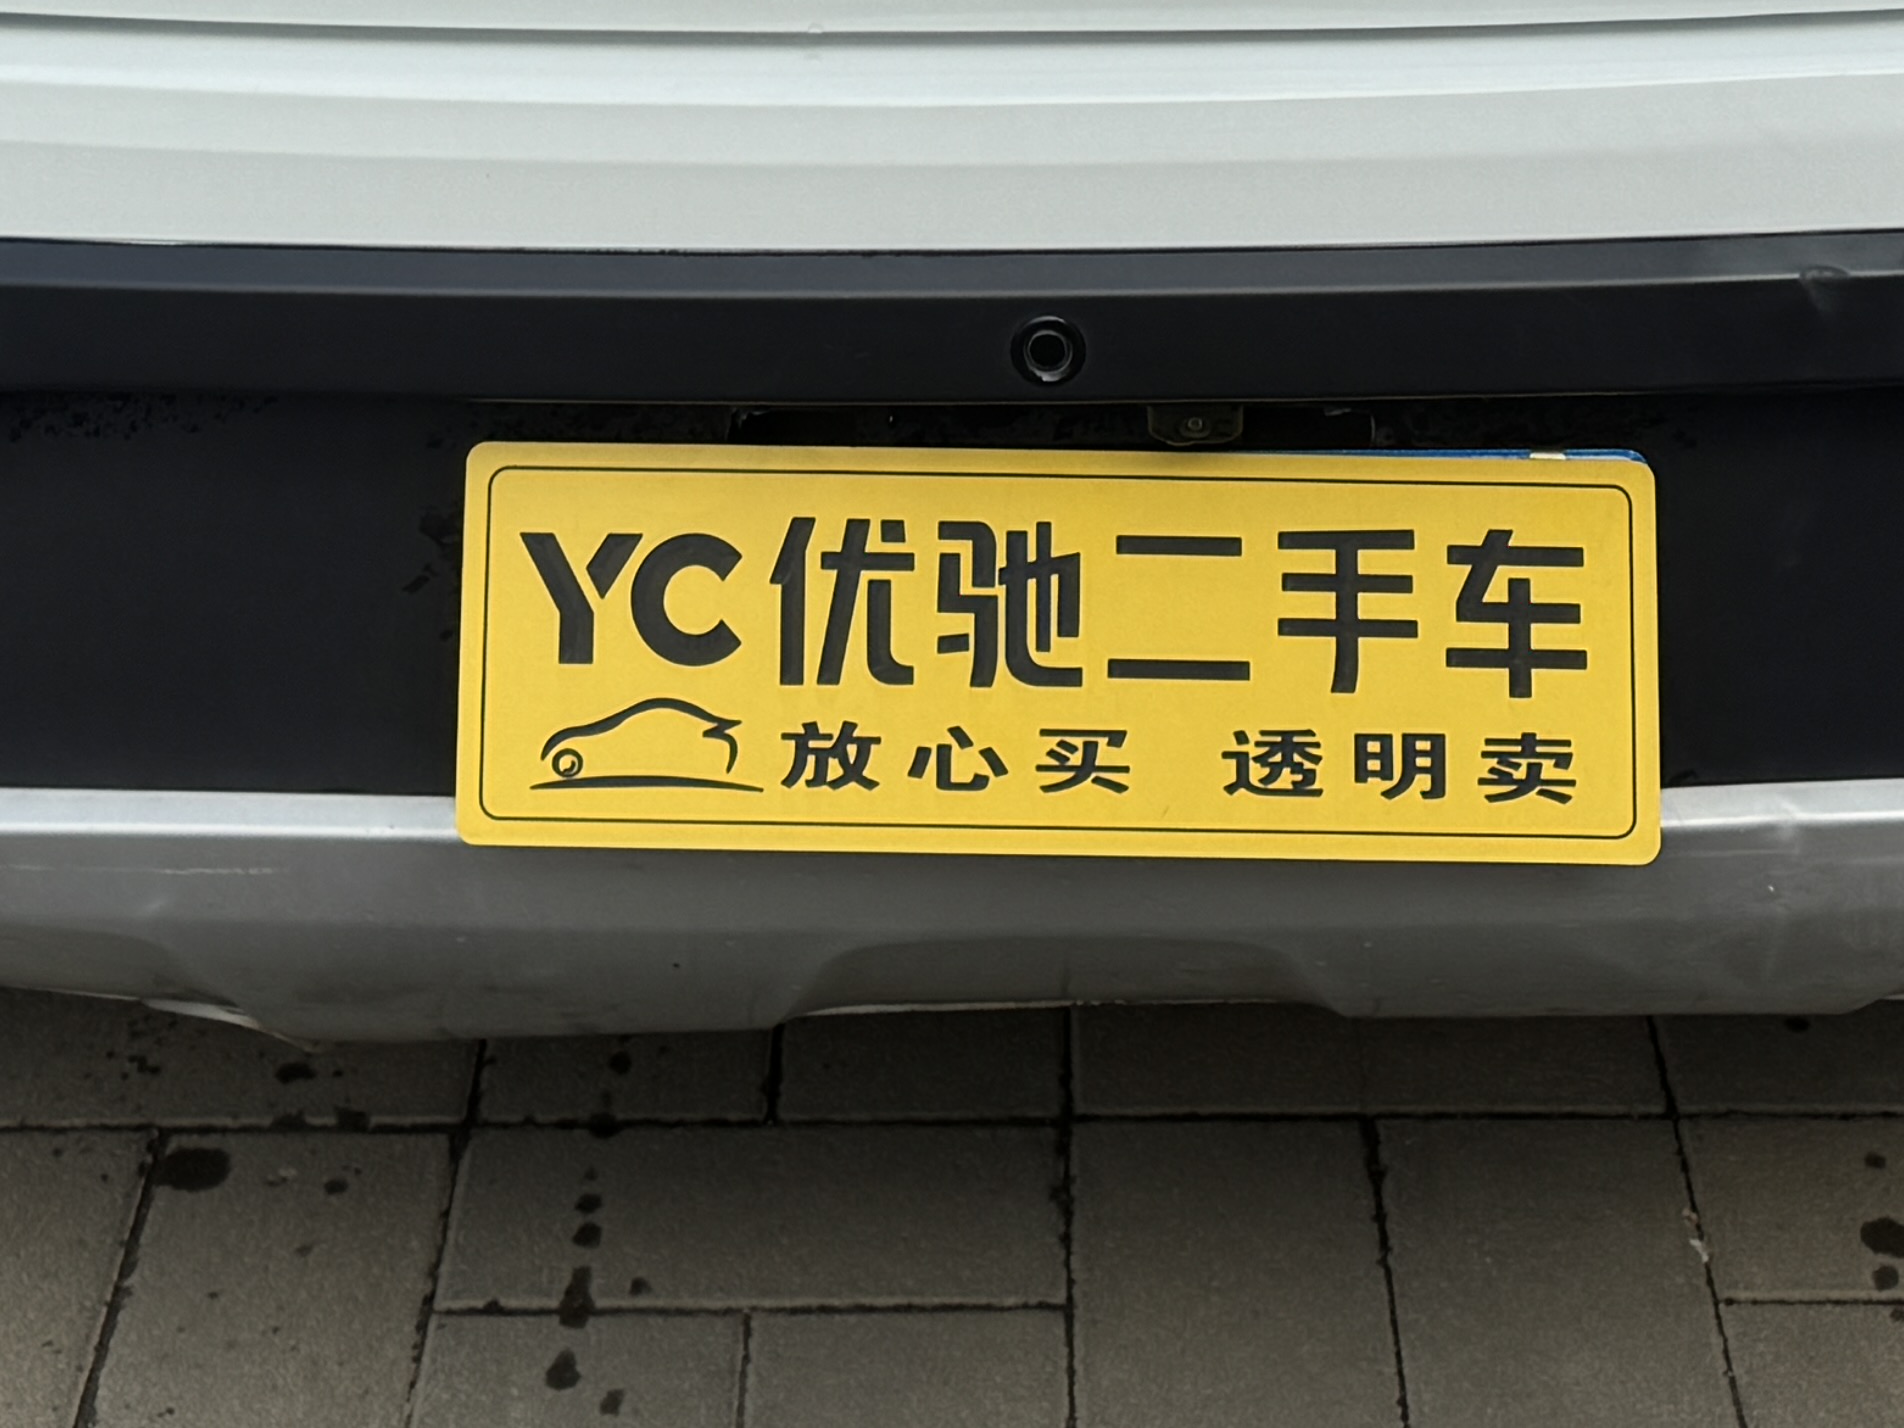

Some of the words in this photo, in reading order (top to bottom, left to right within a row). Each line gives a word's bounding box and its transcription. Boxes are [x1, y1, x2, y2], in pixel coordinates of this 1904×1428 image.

[781, 721, 1130, 793] 放心买
[1222, 729, 1576, 804] 透明卖
